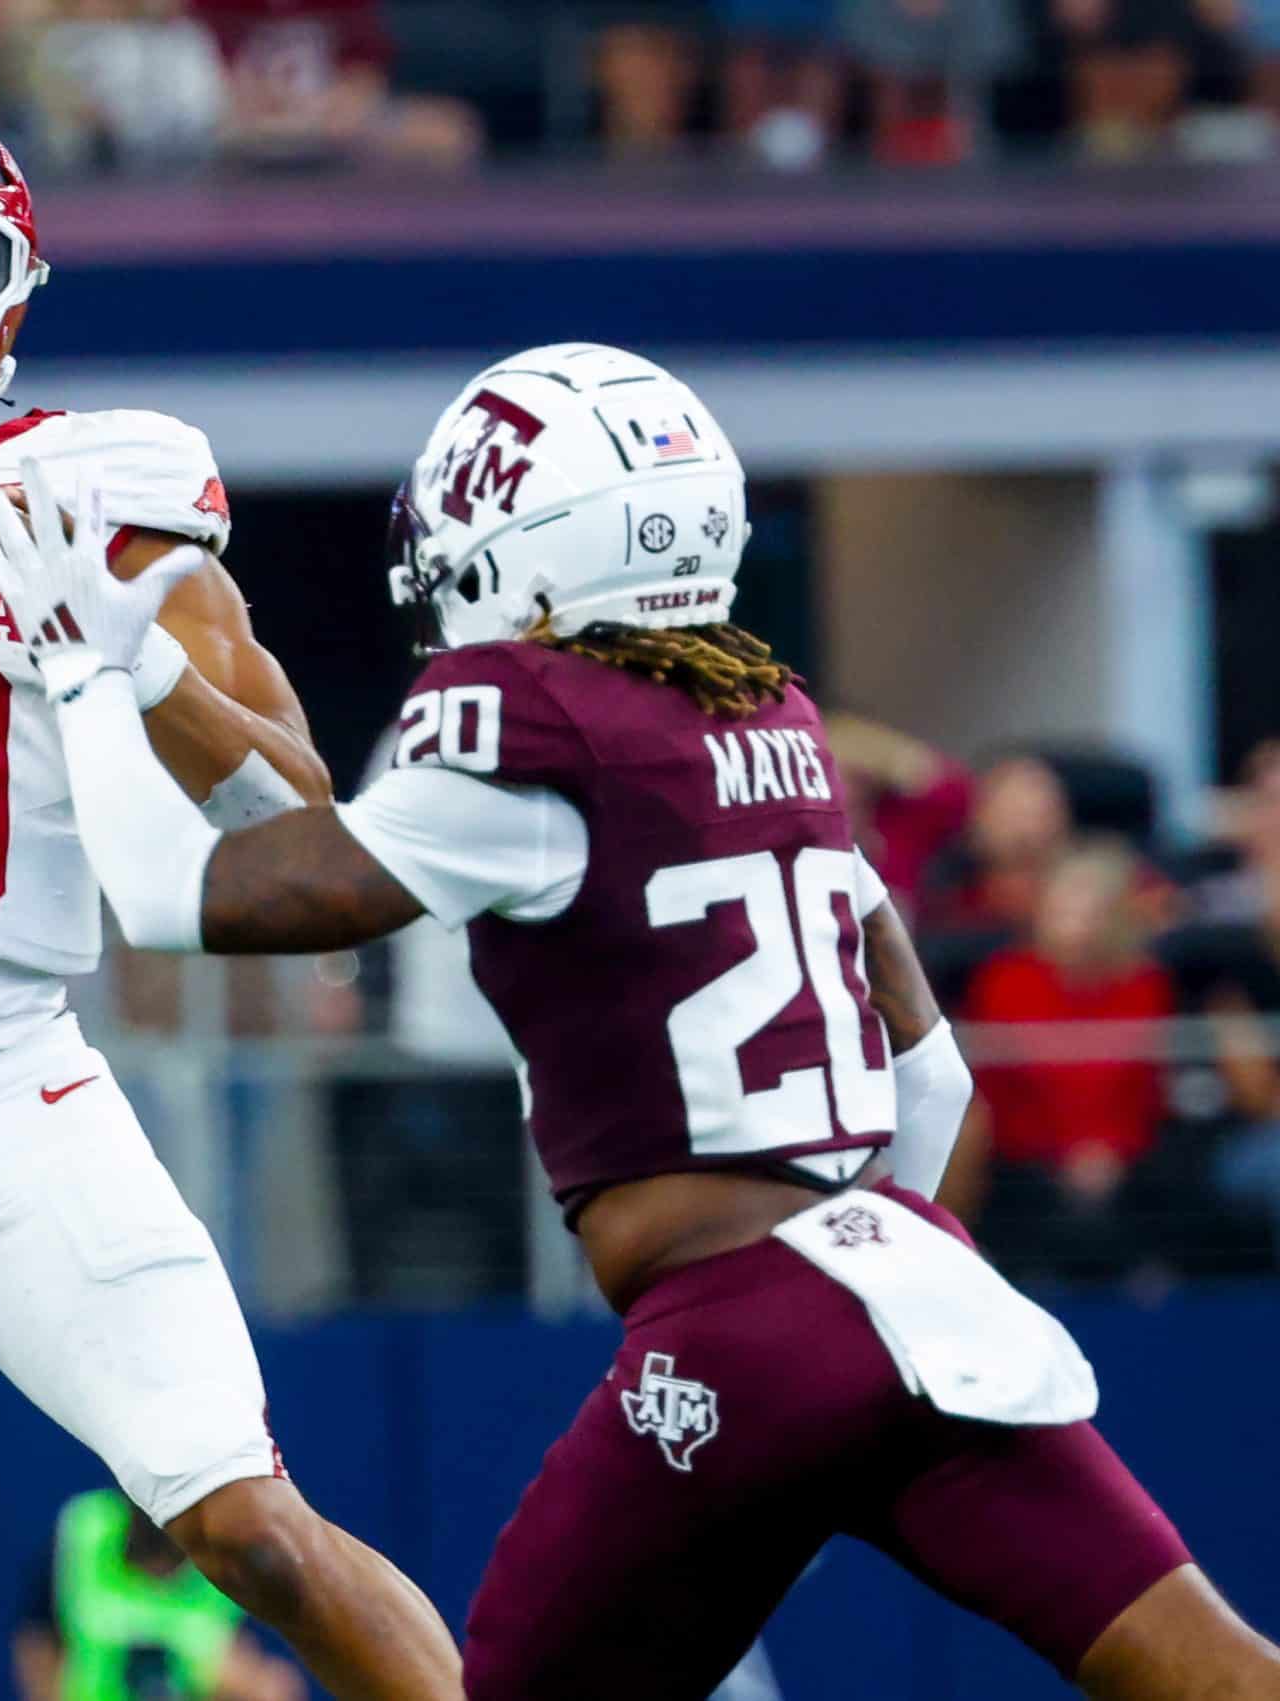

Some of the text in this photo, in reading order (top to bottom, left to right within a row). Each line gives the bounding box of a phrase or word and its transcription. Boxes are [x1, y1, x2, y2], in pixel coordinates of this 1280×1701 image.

[640, 514, 674, 552] SEC
[672, 554, 701, 577] 20
[636, 592, 691, 613] TEXAS
[395, 685, 503, 774] 20
[703, 729, 832, 808] MAYES
[644, 847, 897, 1156] 20
